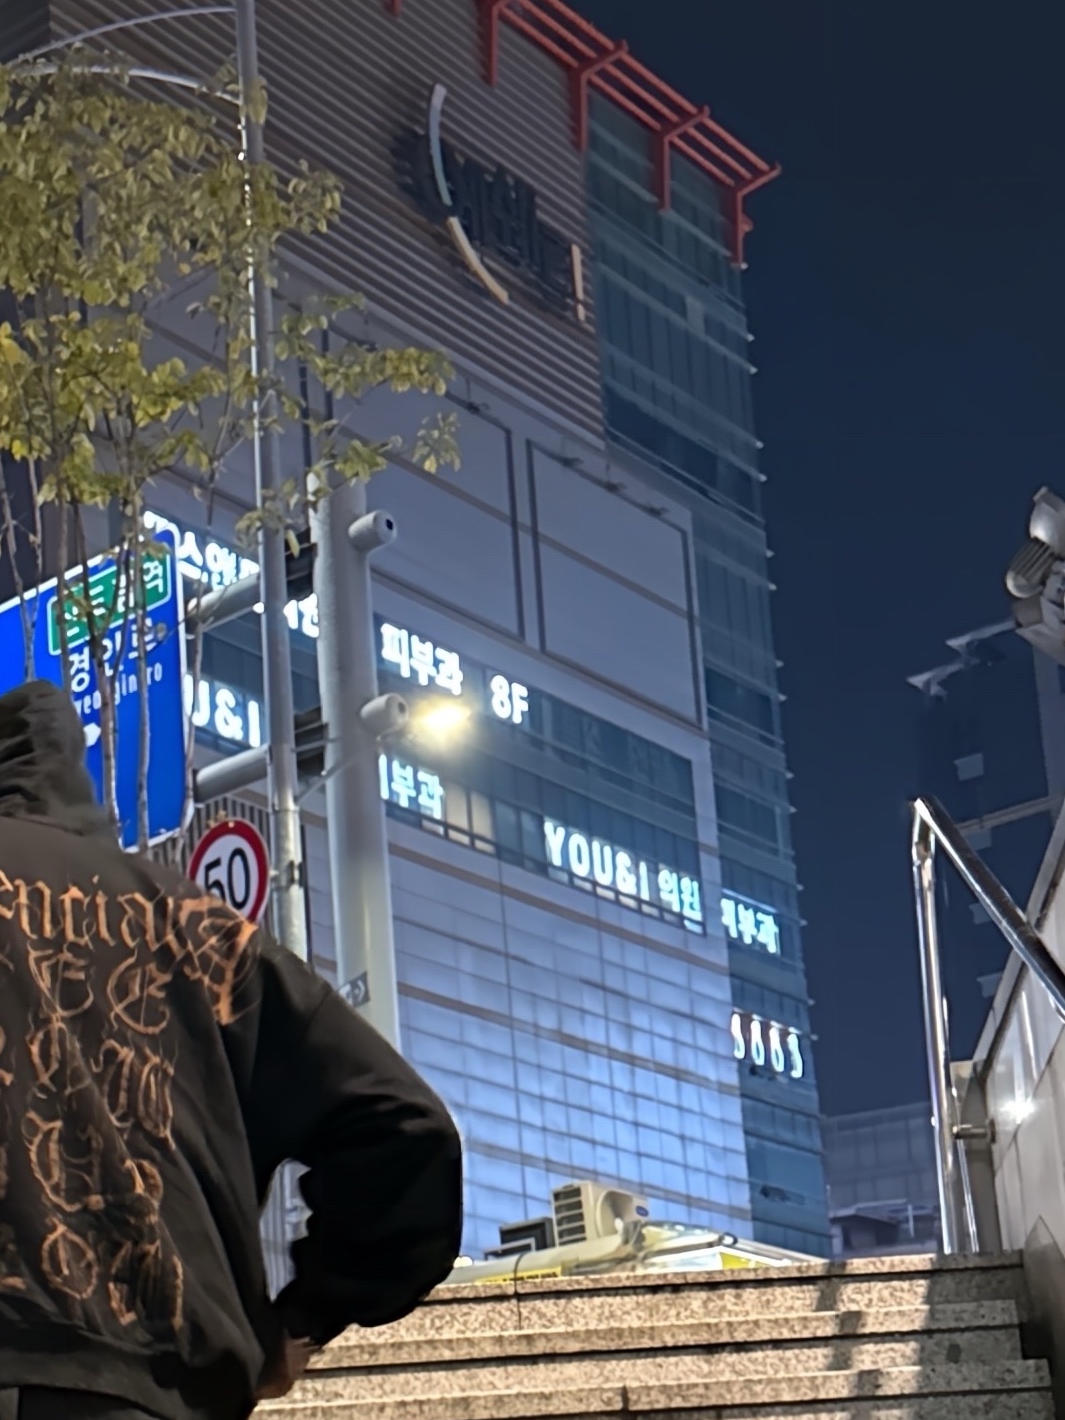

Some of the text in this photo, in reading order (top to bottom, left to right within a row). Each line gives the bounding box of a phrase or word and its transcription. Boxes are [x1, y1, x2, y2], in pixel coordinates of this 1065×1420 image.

[380, 623, 464, 696] 피부과
[490, 674, 529, 724] 8F
[204, 847, 251, 910] 50
[543, 821, 651, 901] YOU&I
[657, 868, 704, 922] 의원
